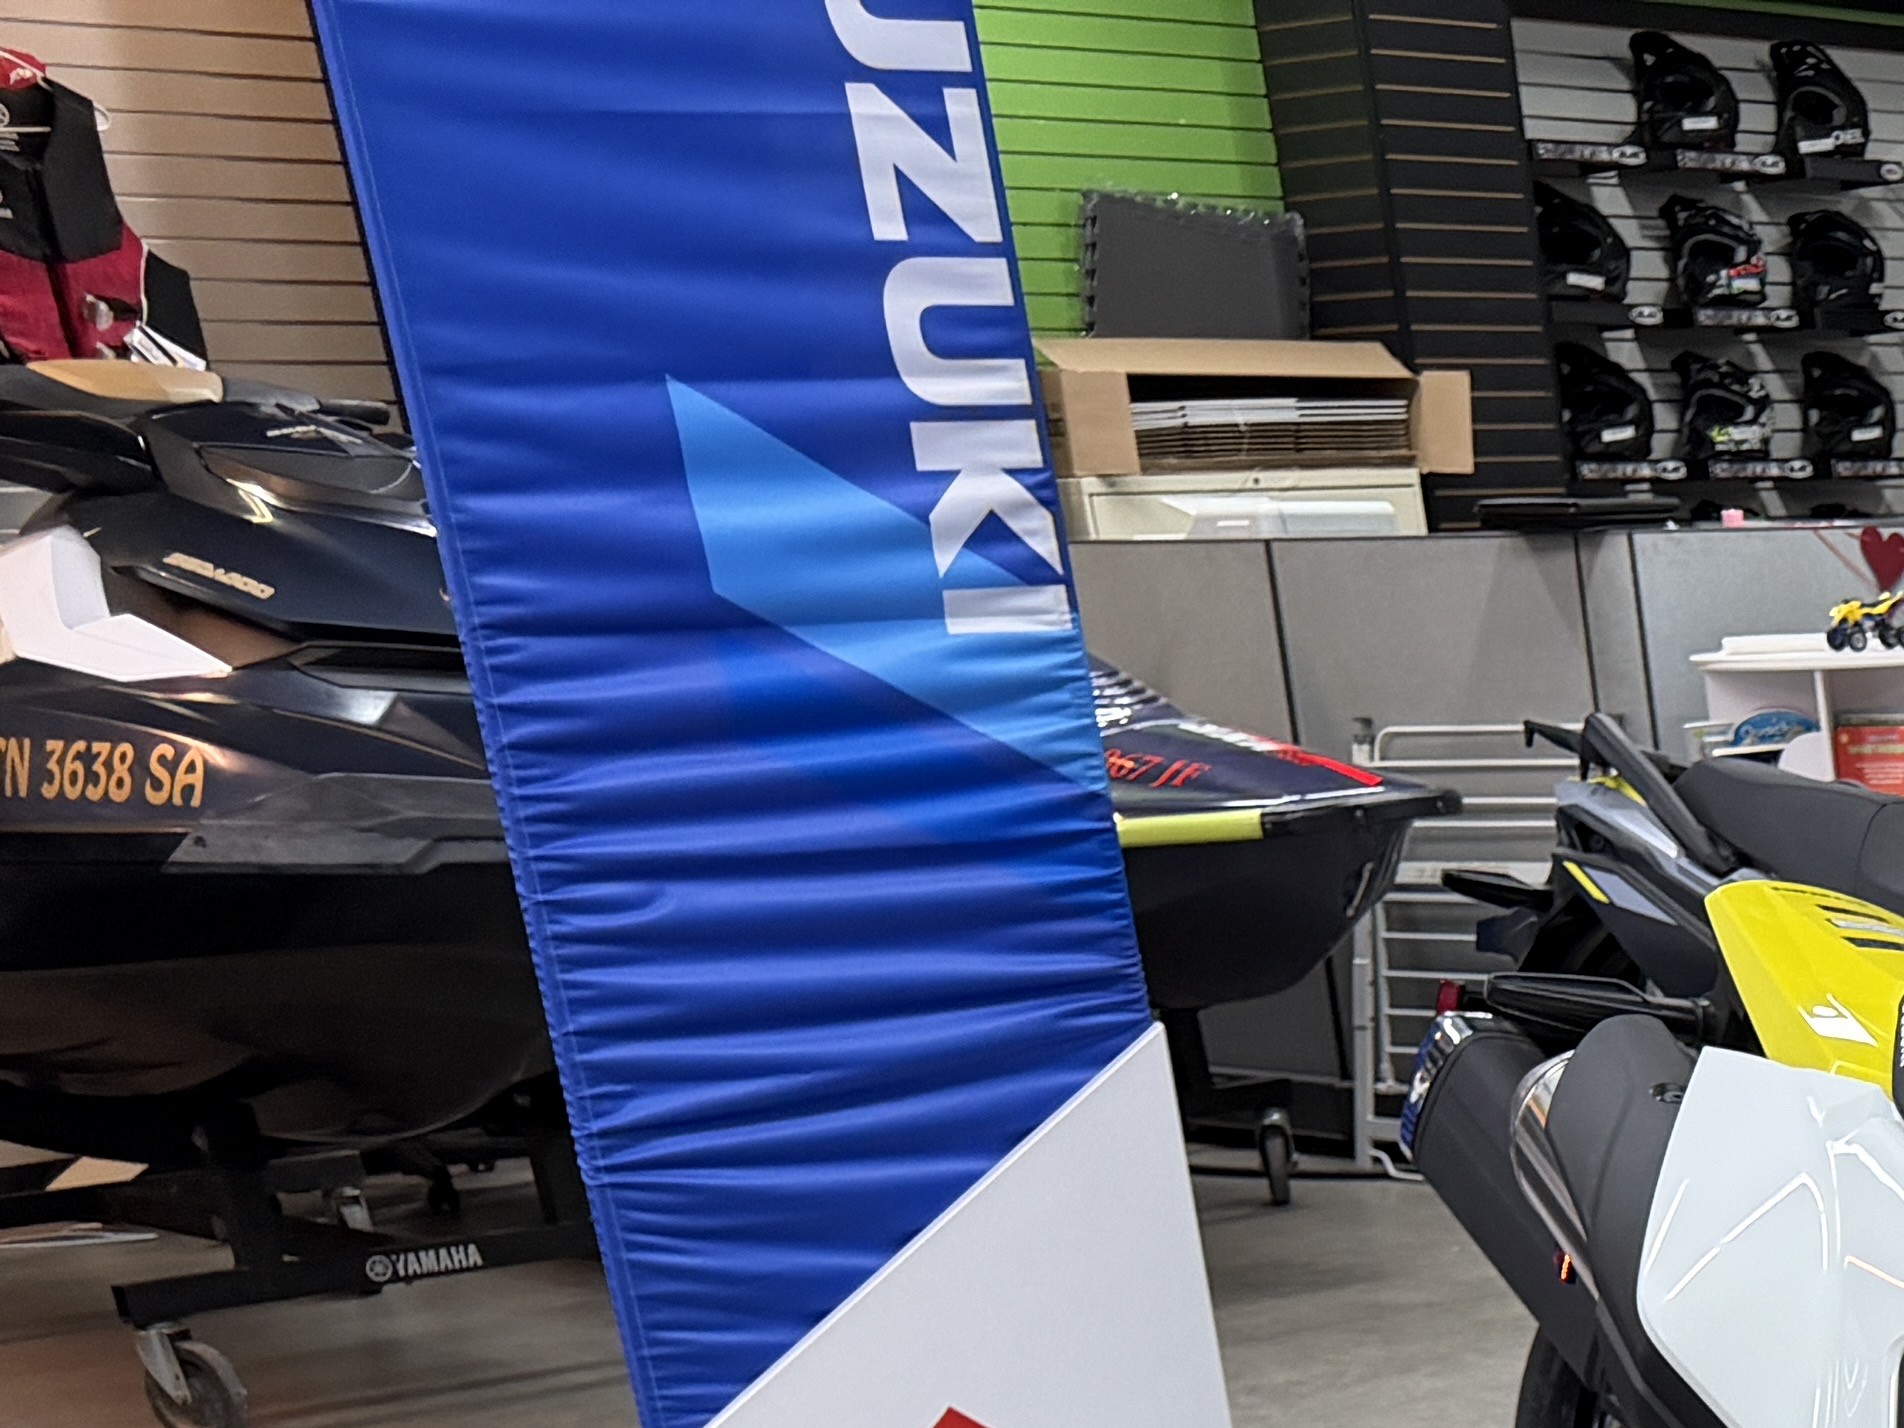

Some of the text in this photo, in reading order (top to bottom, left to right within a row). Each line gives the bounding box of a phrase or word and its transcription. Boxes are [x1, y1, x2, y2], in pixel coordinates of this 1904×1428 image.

[41, 739, 134, 803] 3638
[144, 743, 204, 808] SA
[390, 1243, 483, 1278] YAMAHA
